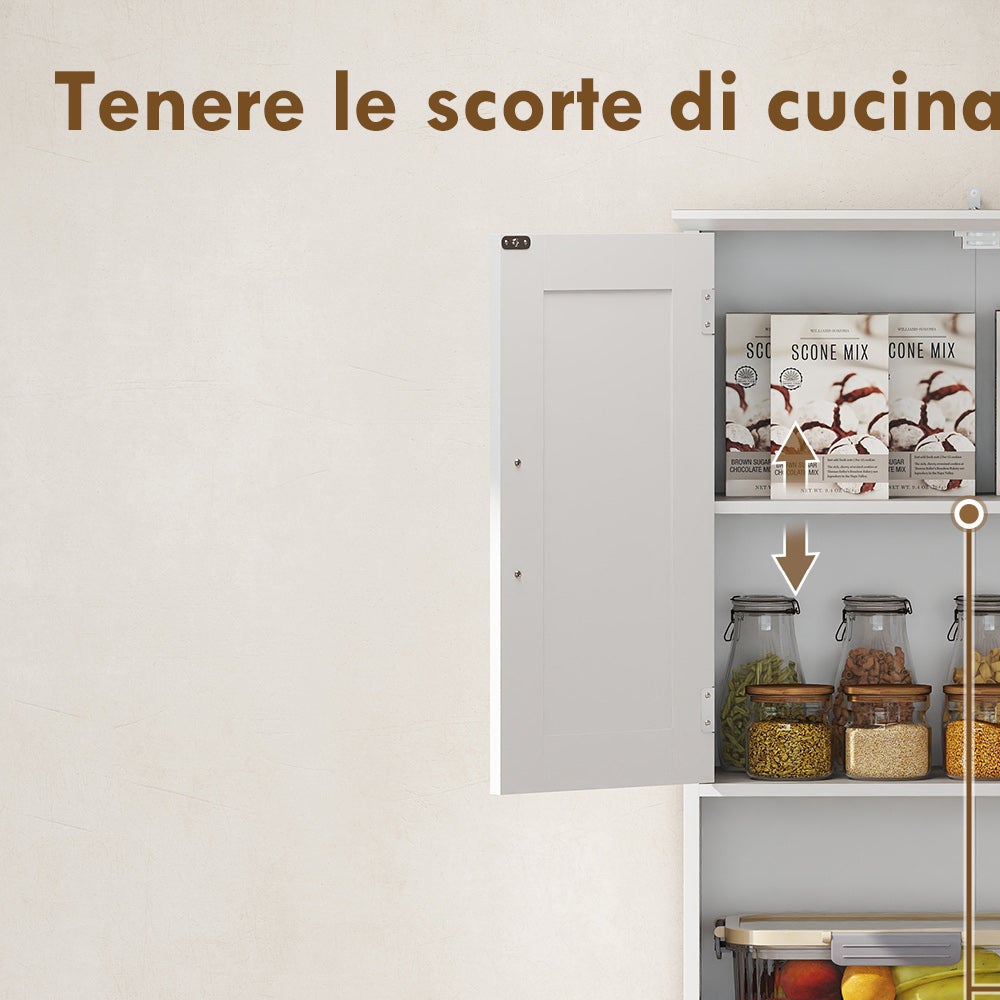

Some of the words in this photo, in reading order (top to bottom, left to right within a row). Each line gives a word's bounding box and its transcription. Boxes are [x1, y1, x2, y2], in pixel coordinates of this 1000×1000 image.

[791, 343, 837, 360] SCONE
[843, 343, 869, 360] MIX
[930, 342, 956, 359] MIX
